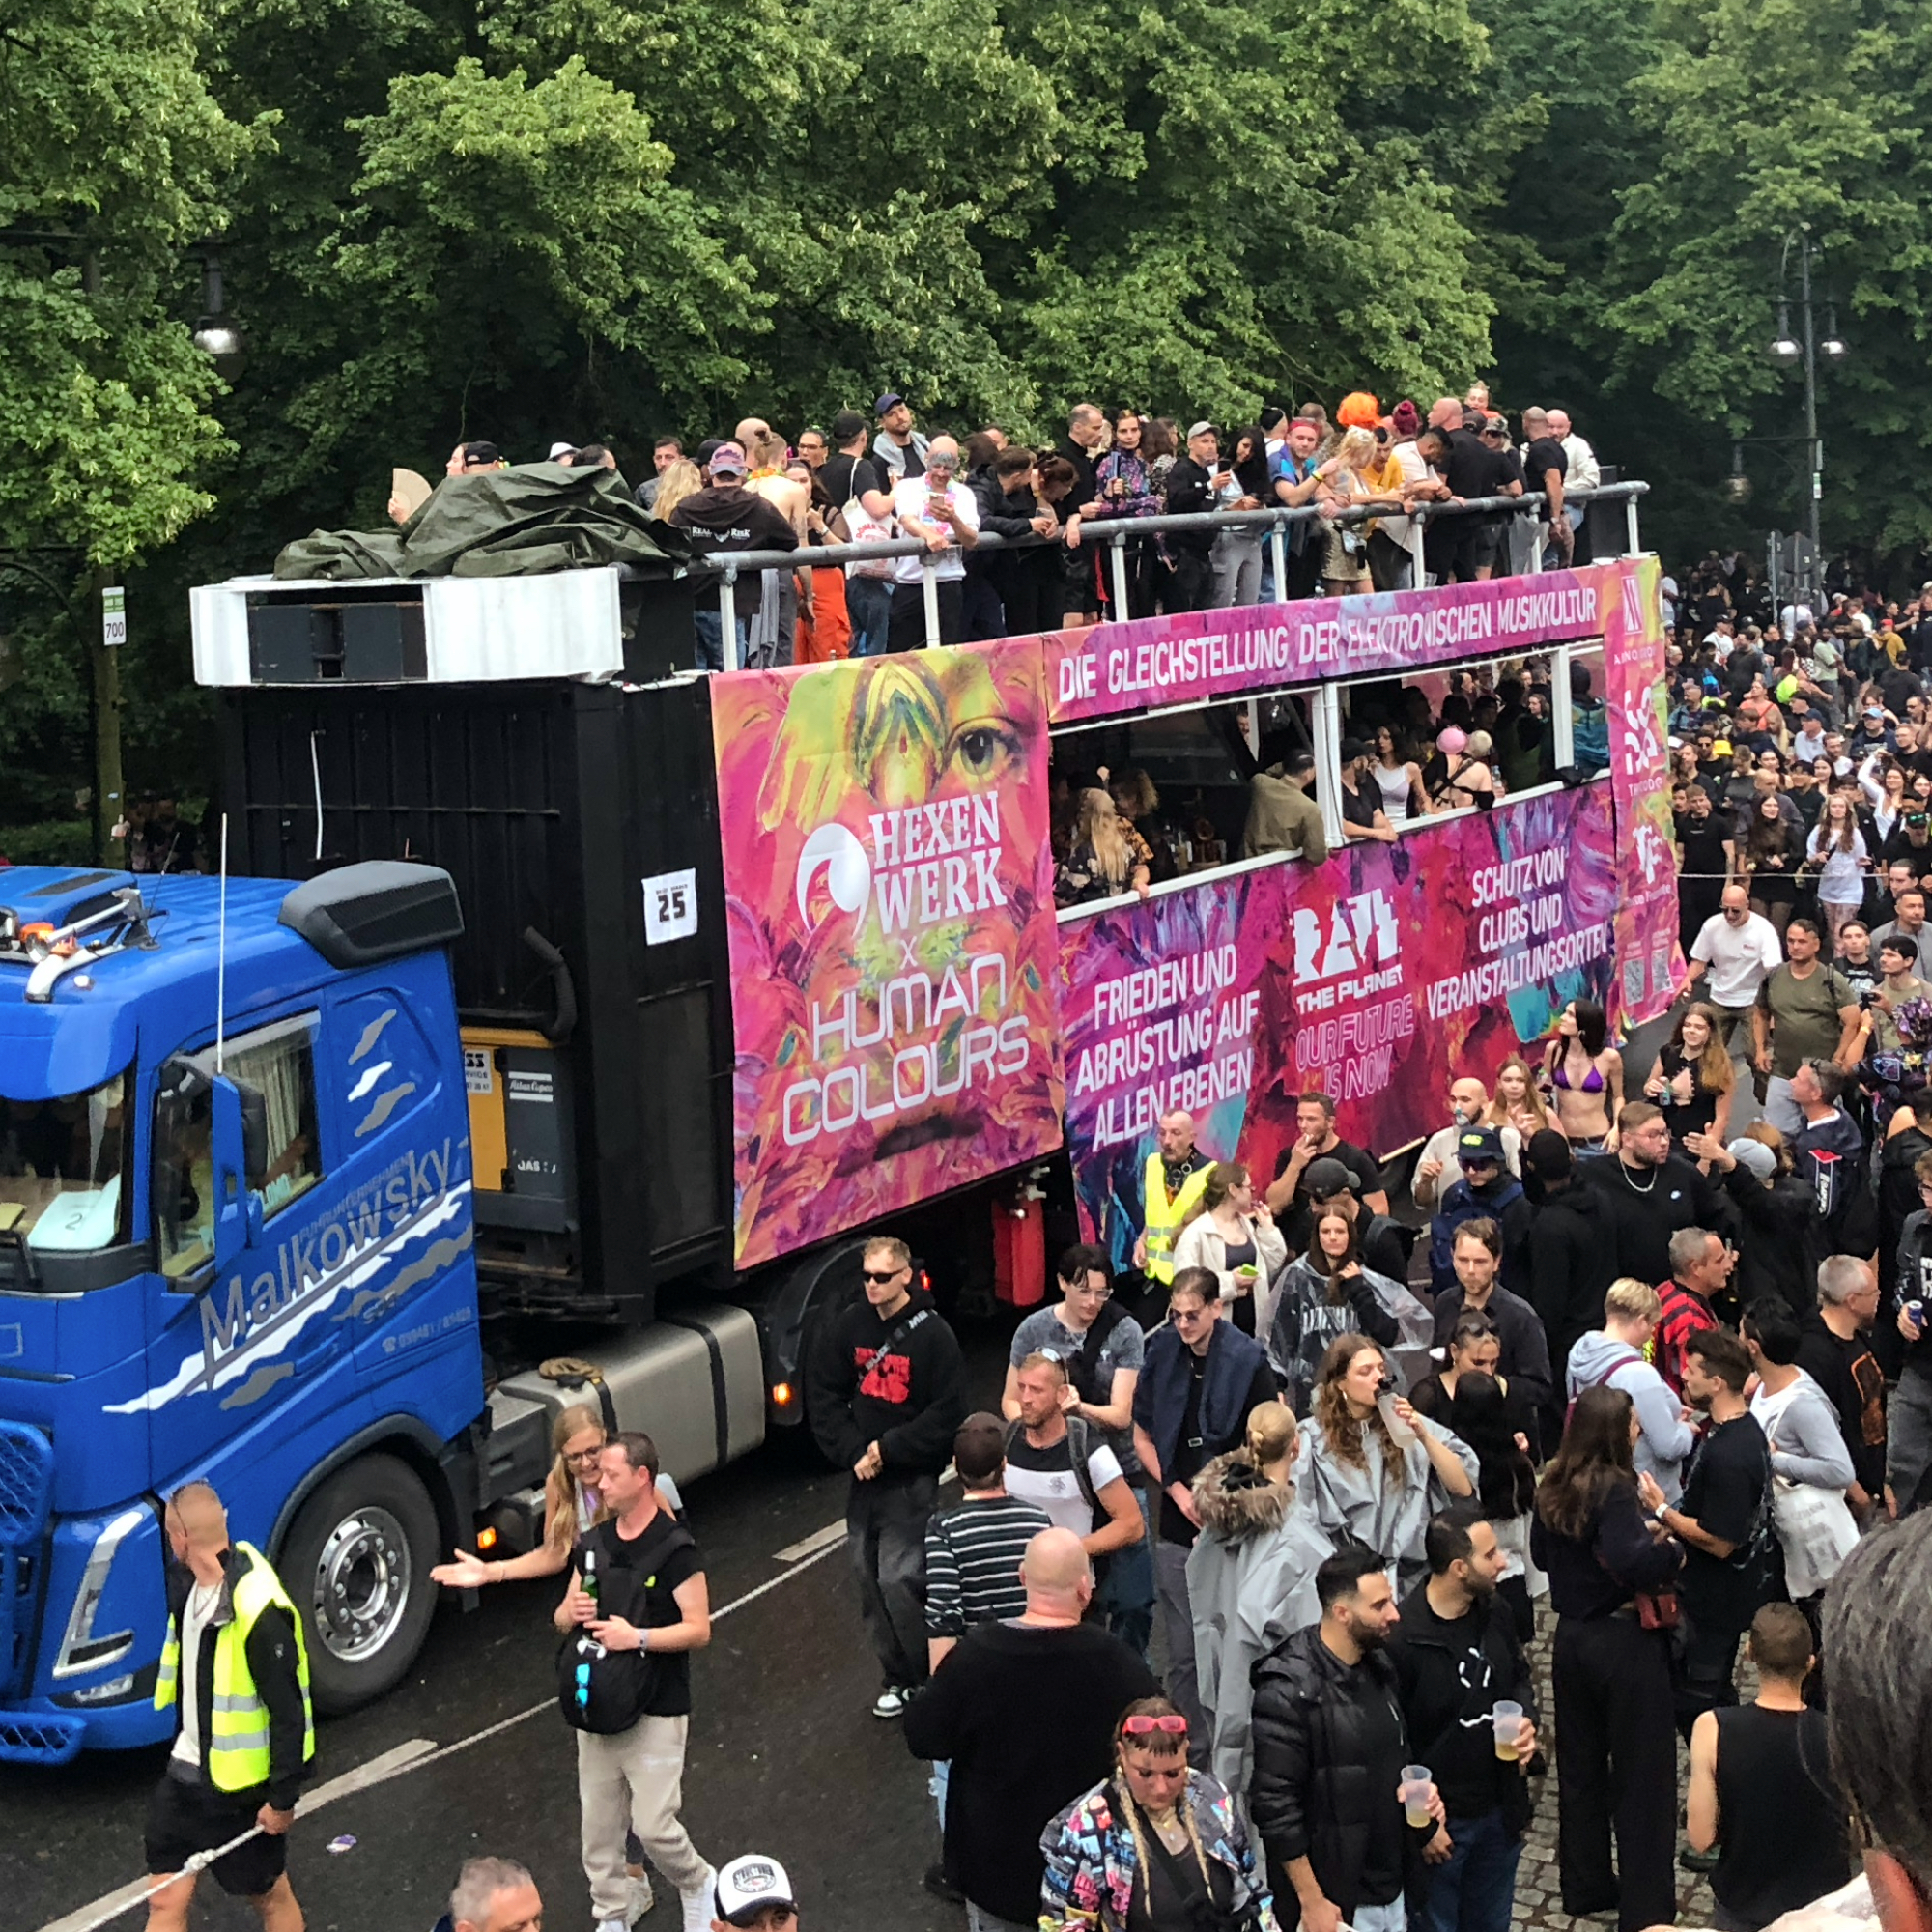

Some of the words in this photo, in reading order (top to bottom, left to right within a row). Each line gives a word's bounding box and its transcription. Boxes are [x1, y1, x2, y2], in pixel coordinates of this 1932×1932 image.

[692, 526, 712, 536] REAL
[730, 527, 751, 538] RISK
[105, 621, 125, 639] 700
[1059, 653, 1097, 703] DIE
[1107, 625, 1289, 695] GLEICHSTELLUNG
[1298, 620, 1339, 665] DER
[1347, 601, 1492, 658] ELEKTRONISCHEN
[1497, 586, 1597, 636] MUSIKKULTUR
[868, 790, 1001, 870] HEXEN
[657, 890, 686, 923] 25
[873, 846, 1008, 935] WERK
[1471, 854, 1533, 908] SCHUTZ
[1534, 845, 1566, 889] VON
[1478, 902, 1529, 954] CLUBS
[1531, 892, 1563, 935] UND
[812, 952, 1007, 1062] HUMAN
[1094, 958, 1188, 1031] FRIEDEN
[1191, 942, 1237, 997] UND
[1296, 984, 1335, 1015] THE
[1338, 963, 1404, 1003] PLANET
[1426, 919, 1608, 1021] VERANSTALTUNGSORTEN
[1073, 1019, 1212, 1098] ABRÜSTUNG
[1216, 989, 1261, 1045] AUF
[1295, 1018, 1338, 1074] OUR
[1337, 993, 1415, 1060] FUTURE
[782, 1014, 1030, 1147] COLOURS
[1092, 1079, 1165, 1154] ALLEN
[1169, 1046, 1252, 1113] EBENEN
[1324, 1061, 1342, 1107] IS
[1344, 1043, 1393, 1101] NOW
[64, 1212, 83, 1231] 2
[199, 1136, 452, 1391] Malkowsky
